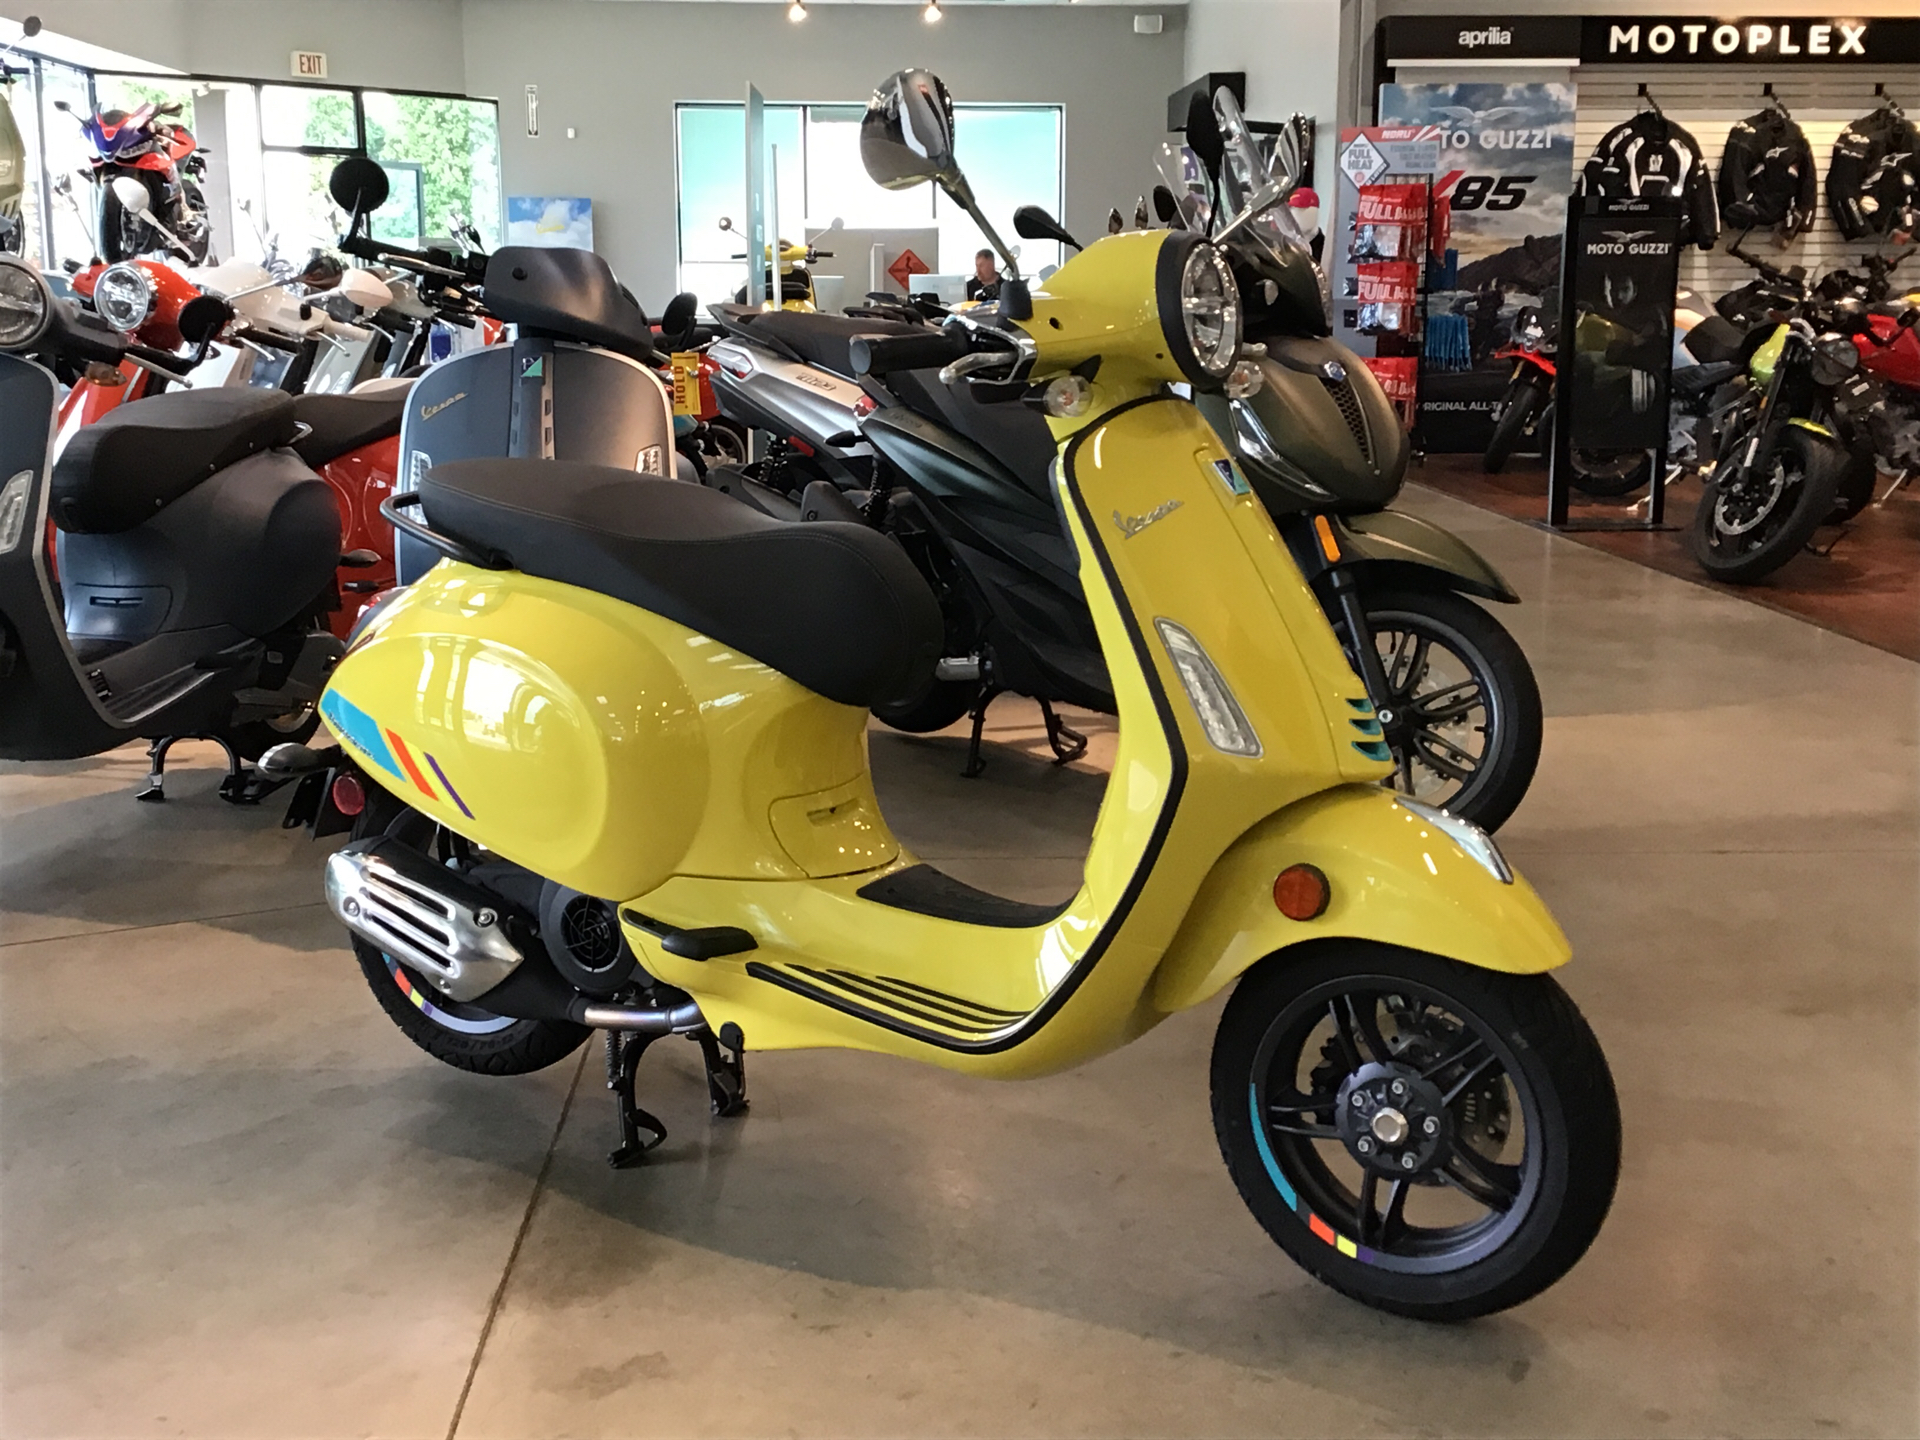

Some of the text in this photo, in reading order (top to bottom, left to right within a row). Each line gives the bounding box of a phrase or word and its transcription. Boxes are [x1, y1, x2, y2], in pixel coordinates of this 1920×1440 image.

[1458, 27, 1512, 48] aprilia
[1609, 25, 1867, 55] MOTOPLEX
[299, 54, 322, 75] EXIT
[1479, 129, 1552, 150] GUZZI
[1348, 148, 1372, 160] FULL
[1347, 160, 1374, 170] HEAT
[1587, 243, 1669, 255] MOTO GUZZI
[674, 366, 686, 404] HOLD
[1112, 500, 1185, 540] Vespa
